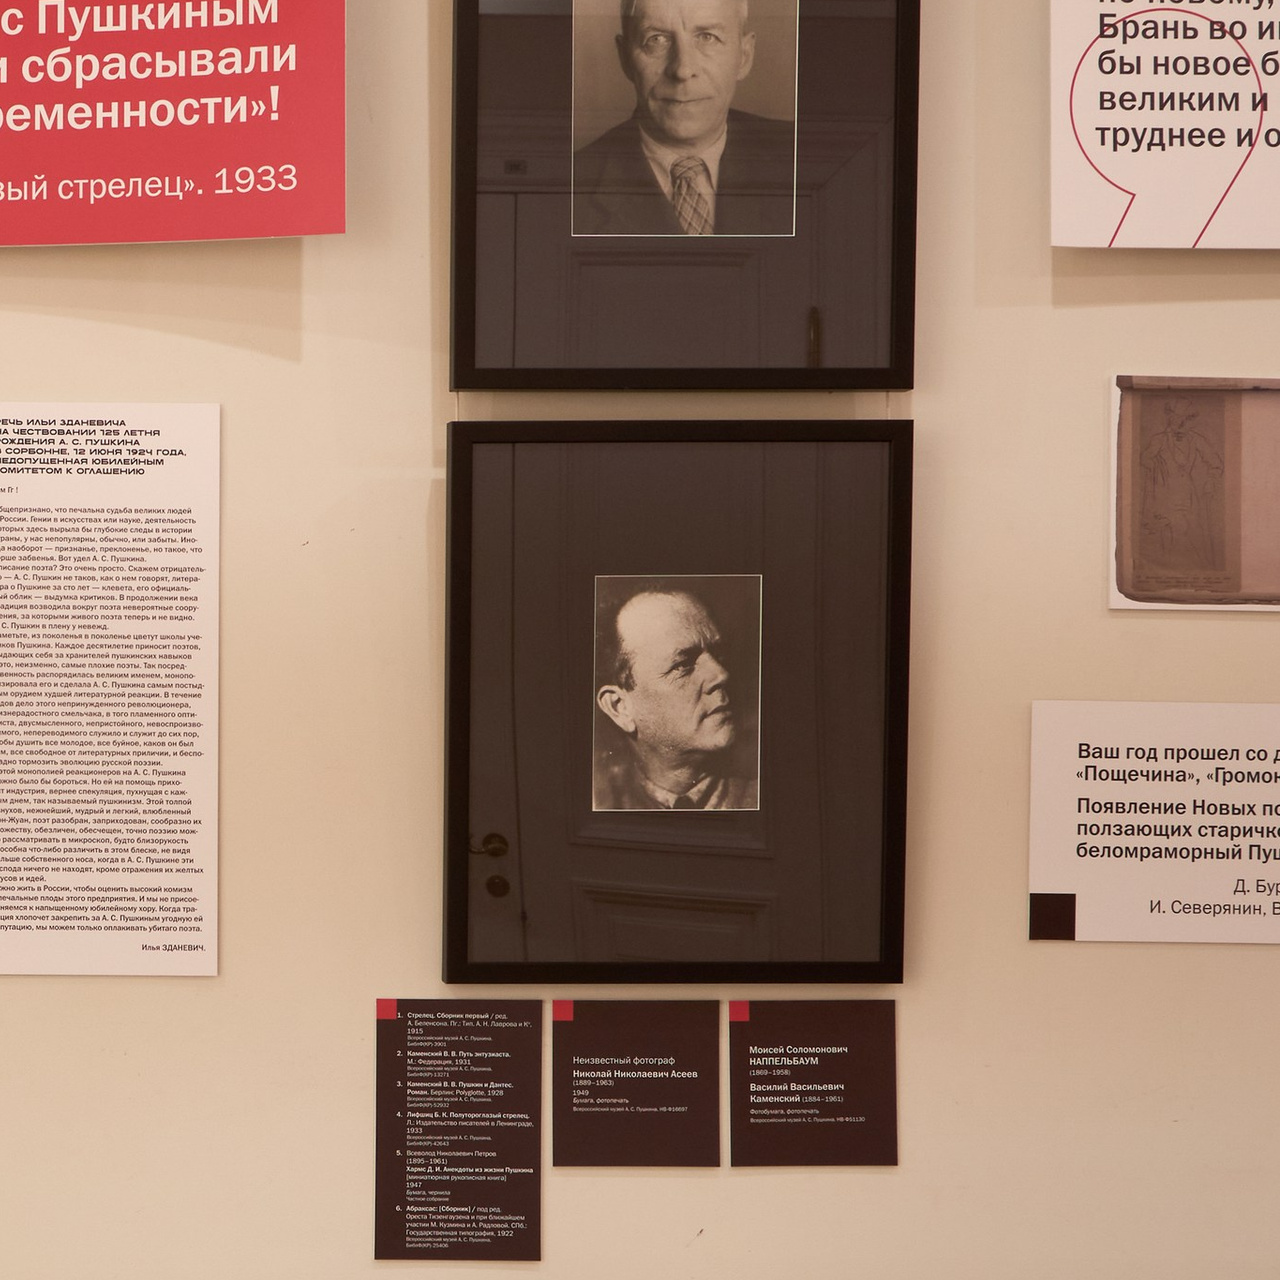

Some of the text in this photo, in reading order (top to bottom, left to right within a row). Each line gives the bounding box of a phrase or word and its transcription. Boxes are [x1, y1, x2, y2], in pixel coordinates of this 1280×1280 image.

[1, 8, 24, 35] с
[1099, 13, 1247, 44] Брань во
[21, 43, 296, 89] сбрасывали
[1099, 50, 1250, 75] бы новое
[1099, 91, 1268, 111] великим и
[1095, 127, 1253, 152] труднее и
[57, 176, 203, 205] стрелец».
[215, 164, 297, 194] 1933
[12, 428, 97, 436] ЧЕСТВОВАНИИ
[99, 429, 121, 437] 125
[123, 429, 161, 437] ЛЕТНЯ
[59, 419, 127, 427] ЗДАНЕВИЧА
[65, 467, 73, 475] К
[76, 467, 145, 475] ОГЛАШЕНИЮ
[91, 457, 165, 466] ЮБИЛЕЙНЫМ
[1078, 742, 1268, 764] Ваш год прошел со
[1076, 765, 1201, 786] «Пощечина»,
[1077, 797, 1257, 816] Появление Новых
[1077, 823, 1193, 840] ползающих
[1076, 841, 1242, 863] беломраморный
[1233, 878, 1251, 896] Д.
[1149, 899, 1267, 918] И. Северянин,
[141, 943, 206, 952] Илья ЗДАНЕВИЧ.
[749, 1045, 848, 1055] Моисей Соломонович
[749, 1056, 819, 1066] НАППЕЛЬБАУМ
[573, 1069, 699, 1079] Николай Николаевич Асеев
